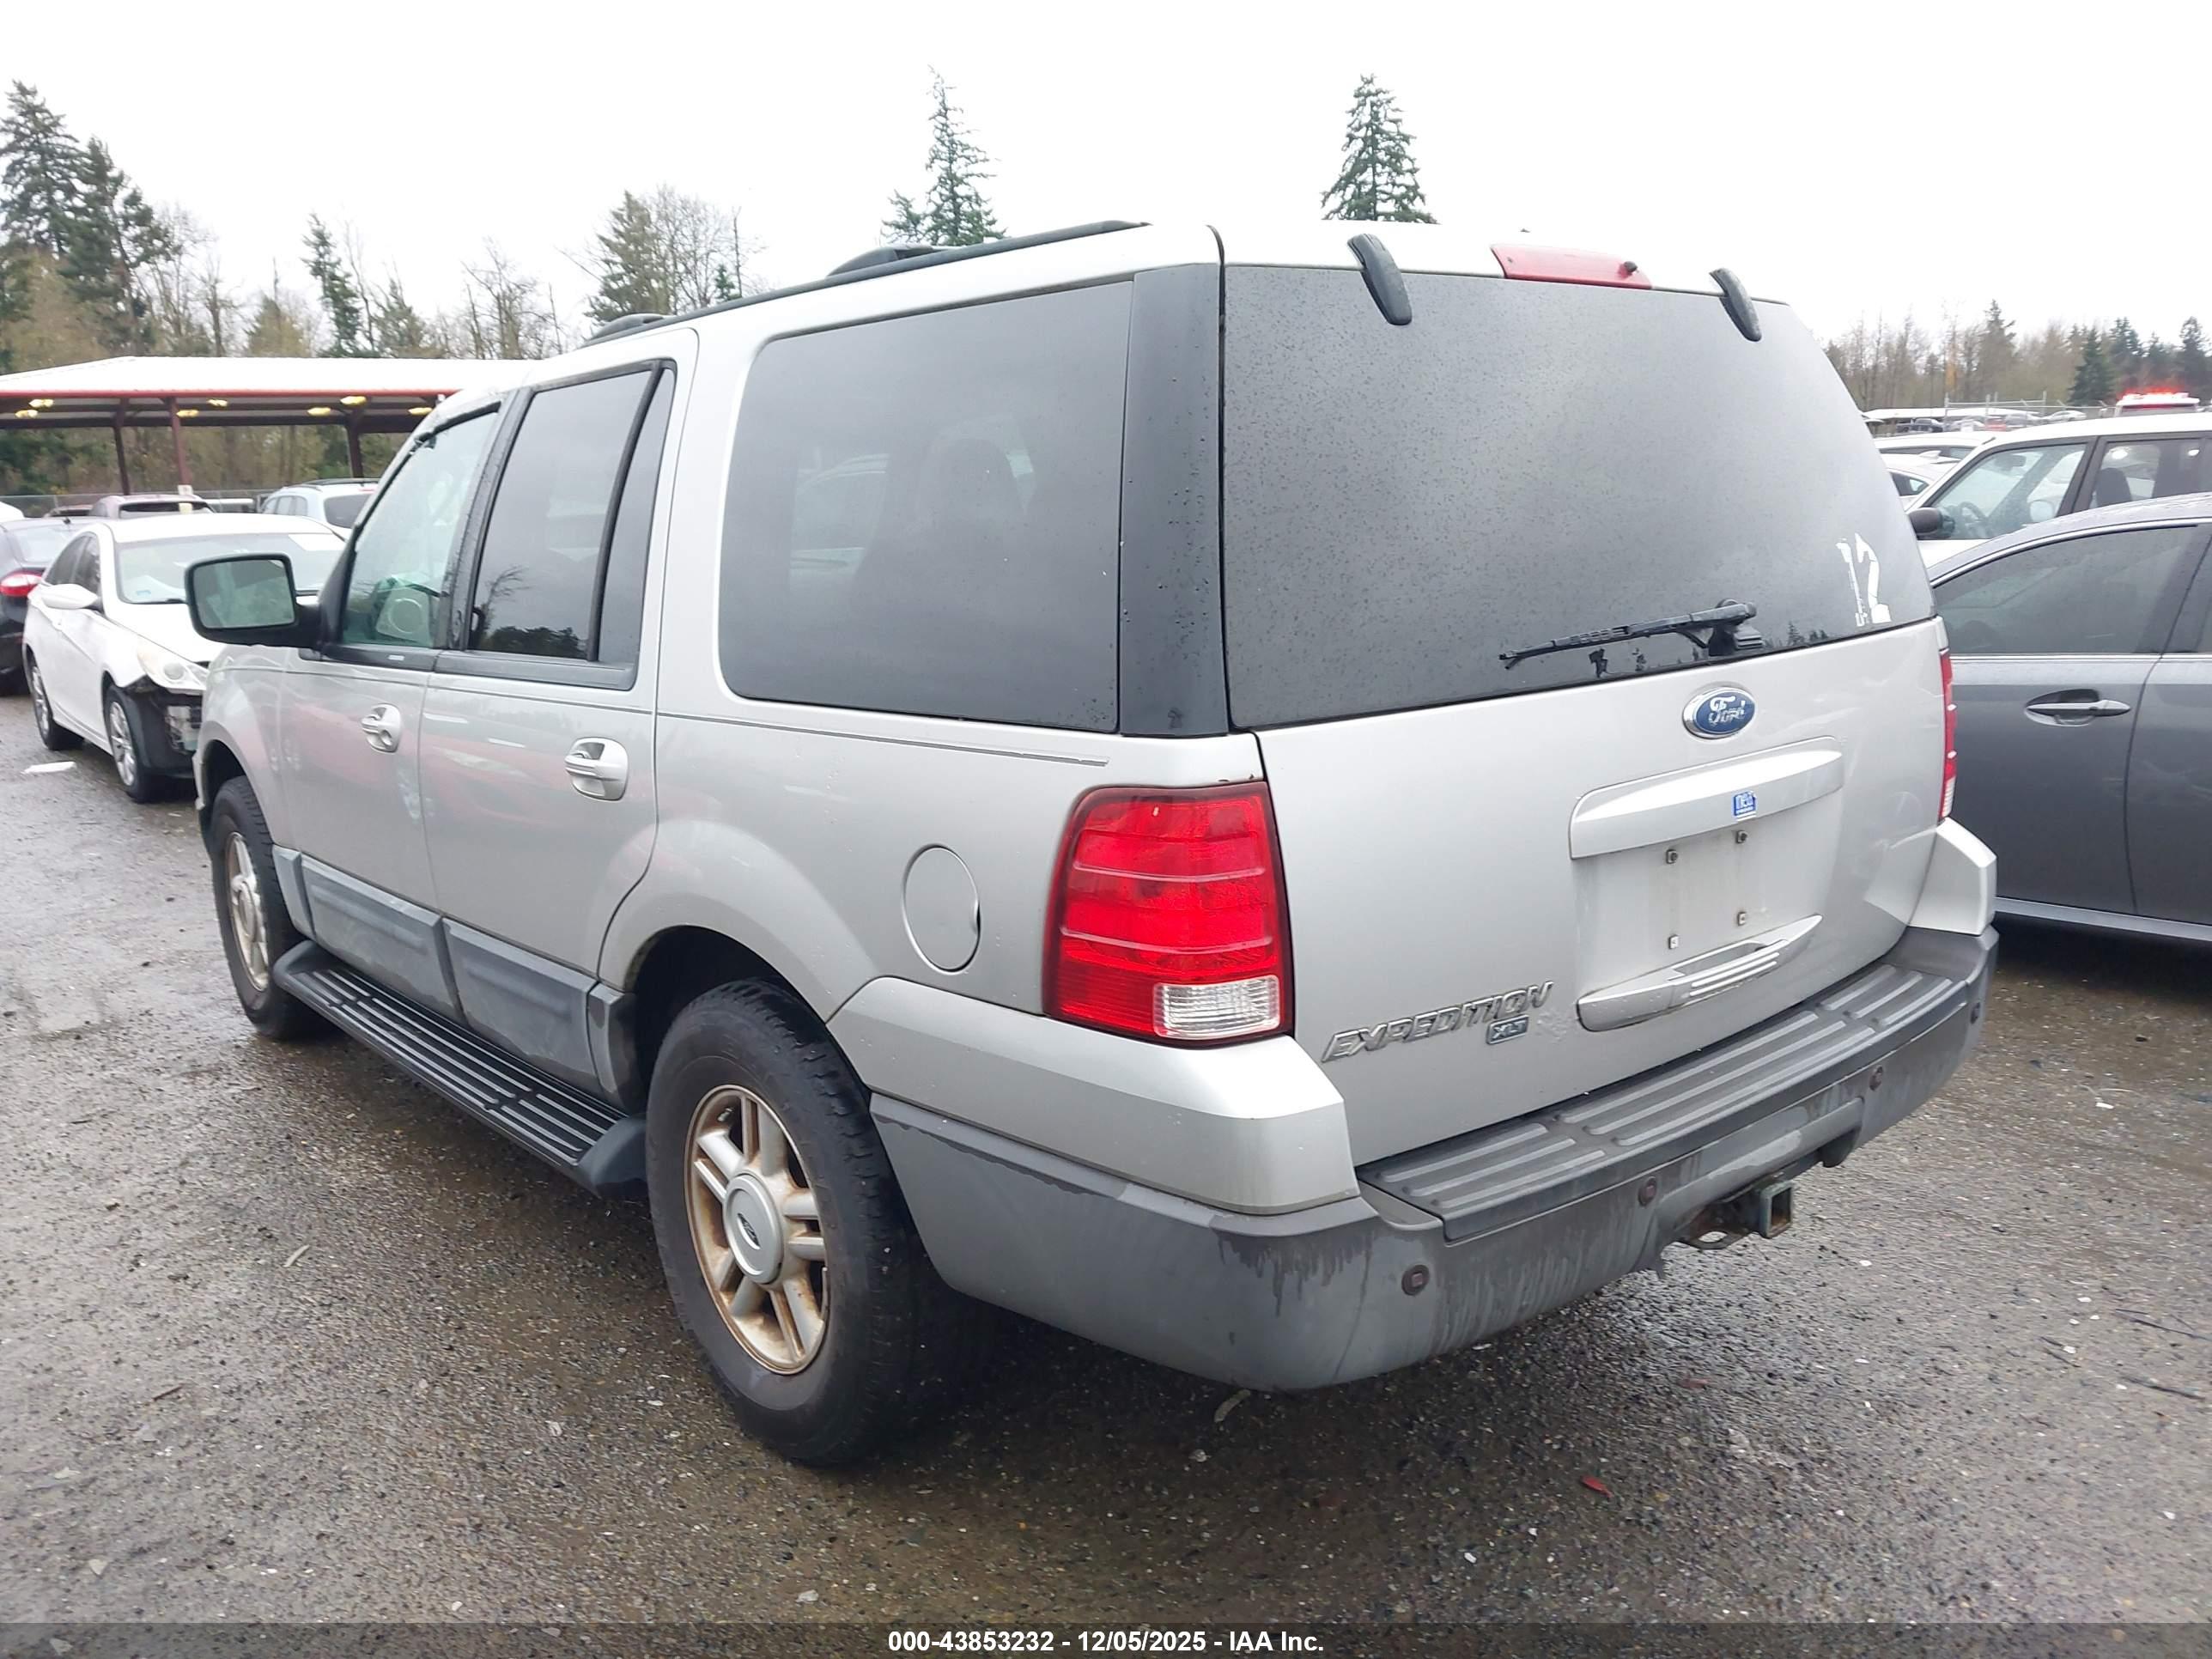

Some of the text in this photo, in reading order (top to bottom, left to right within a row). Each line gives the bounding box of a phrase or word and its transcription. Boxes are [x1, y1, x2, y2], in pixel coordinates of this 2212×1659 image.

[1707, 695, 1747, 727] Ford
[1322, 980, 1554, 1062] EXPEDITION
[1490, 1018, 1528, 1042] XLT
